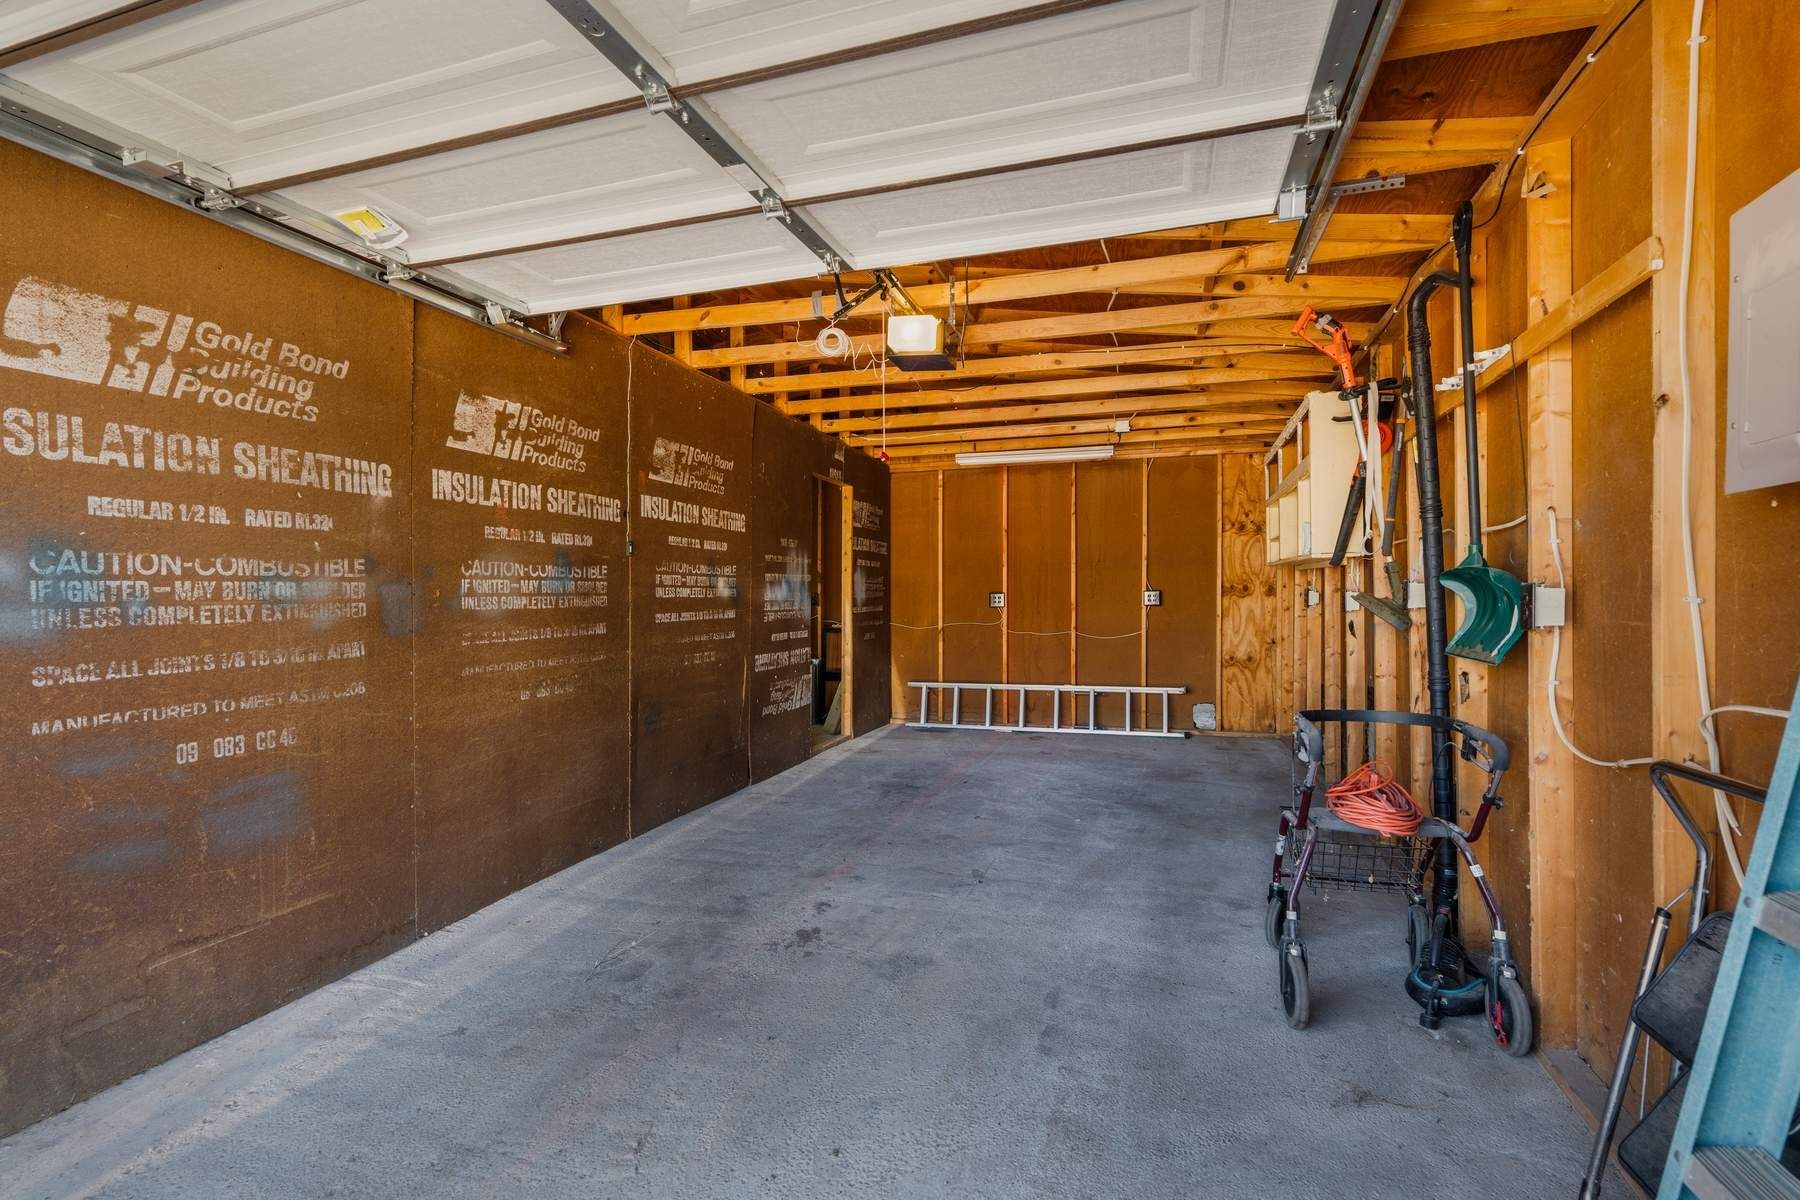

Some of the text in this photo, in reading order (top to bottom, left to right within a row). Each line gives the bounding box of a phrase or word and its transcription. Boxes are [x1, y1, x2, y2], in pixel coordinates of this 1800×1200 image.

[194, 321, 350, 379] Gold Bond
[172, 373, 319, 422] Products
[531, 409, 600, 442] Gold Bond
[2, 407, 393, 497] SULATION SHEATHING
[521, 445, 586, 473] Products
[694, 448, 734, 471] Gold Bond
[689, 475, 725, 495] Products
[692, 462, 724, 484] uilding
[431, 468, 621, 523] INSULATION SHEATHING
[87, 495, 174, 521] REGULAR
[179, 504, 205, 523] 1/2
[245, 508, 292, 528] RATED
[640, 494, 746, 533] INSULATION SHEATHING
[523, 530, 535, 543] 12
[29, 580, 52, 602] IF
[60, 580, 150, 602] IGNITED
[174, 580, 216, 600] MAY
[222, 580, 270, 601] BURN
[273, 580, 296, 599] OR
[461, 579, 471, 594] IF
[473, 579, 511, 594] IGNITED
[520, 580, 539, 594] MAY
[541, 580, 563, 594] BURN
[655, 587, 675, 598] UNLESS
[31, 606, 122, 630] UNLESS
[128, 603, 255, 626] COMPLETELY
[461, 596, 498, 610] UNLESS
[501, 596, 556, 610] COMPLETELY
[31, 663, 101, 687] SPACE
[105, 660, 144, 680] ALL
[147, 654, 216, 676] JOINTS
[31, 702, 208, 736] MANUFACTURED
[214, 699, 236, 713] TO
[240, 692, 284, 709] MEET
[176, 742, 198, 764] 09
[213, 735, 245, 758] 083
